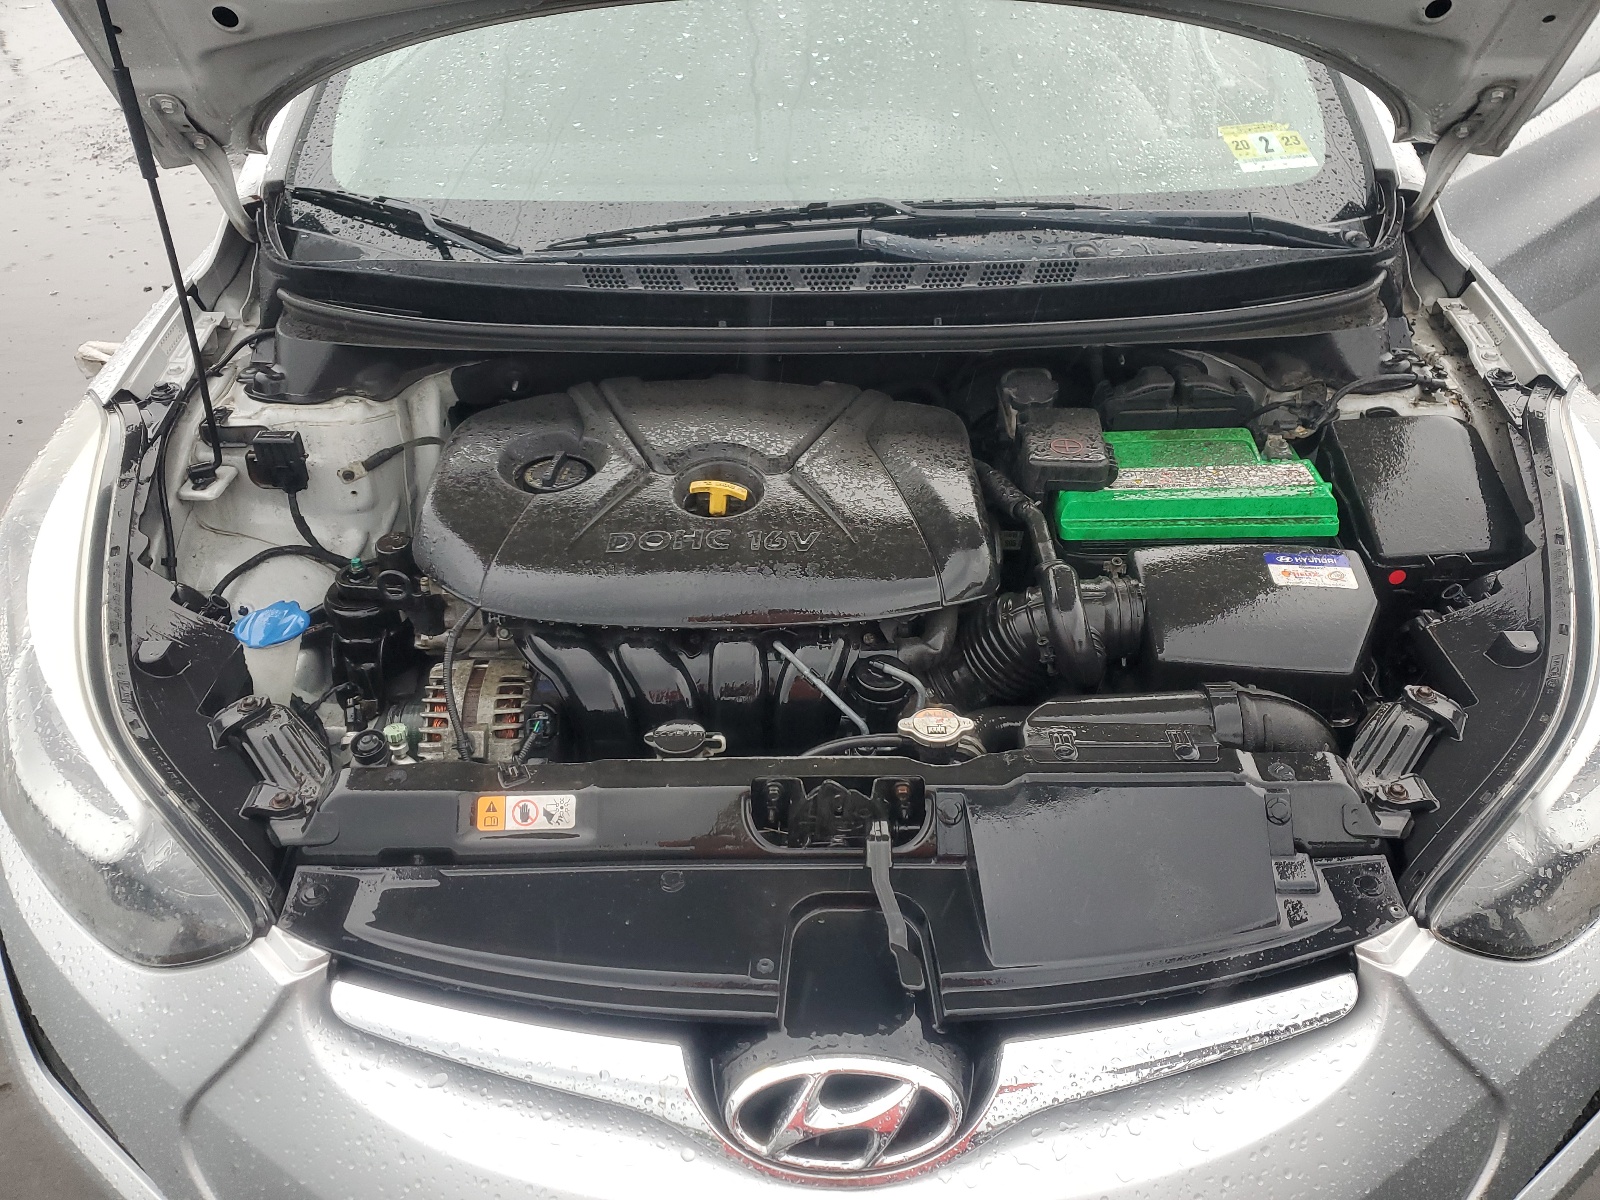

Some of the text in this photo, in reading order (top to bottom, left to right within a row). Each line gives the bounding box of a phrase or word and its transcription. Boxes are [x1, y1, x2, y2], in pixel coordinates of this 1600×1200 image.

[1231, 135, 1301, 154] 20 2 23
[605, 529, 822, 553] DOHC 16V
[1294, 556, 1337, 565] HYUNDAI
